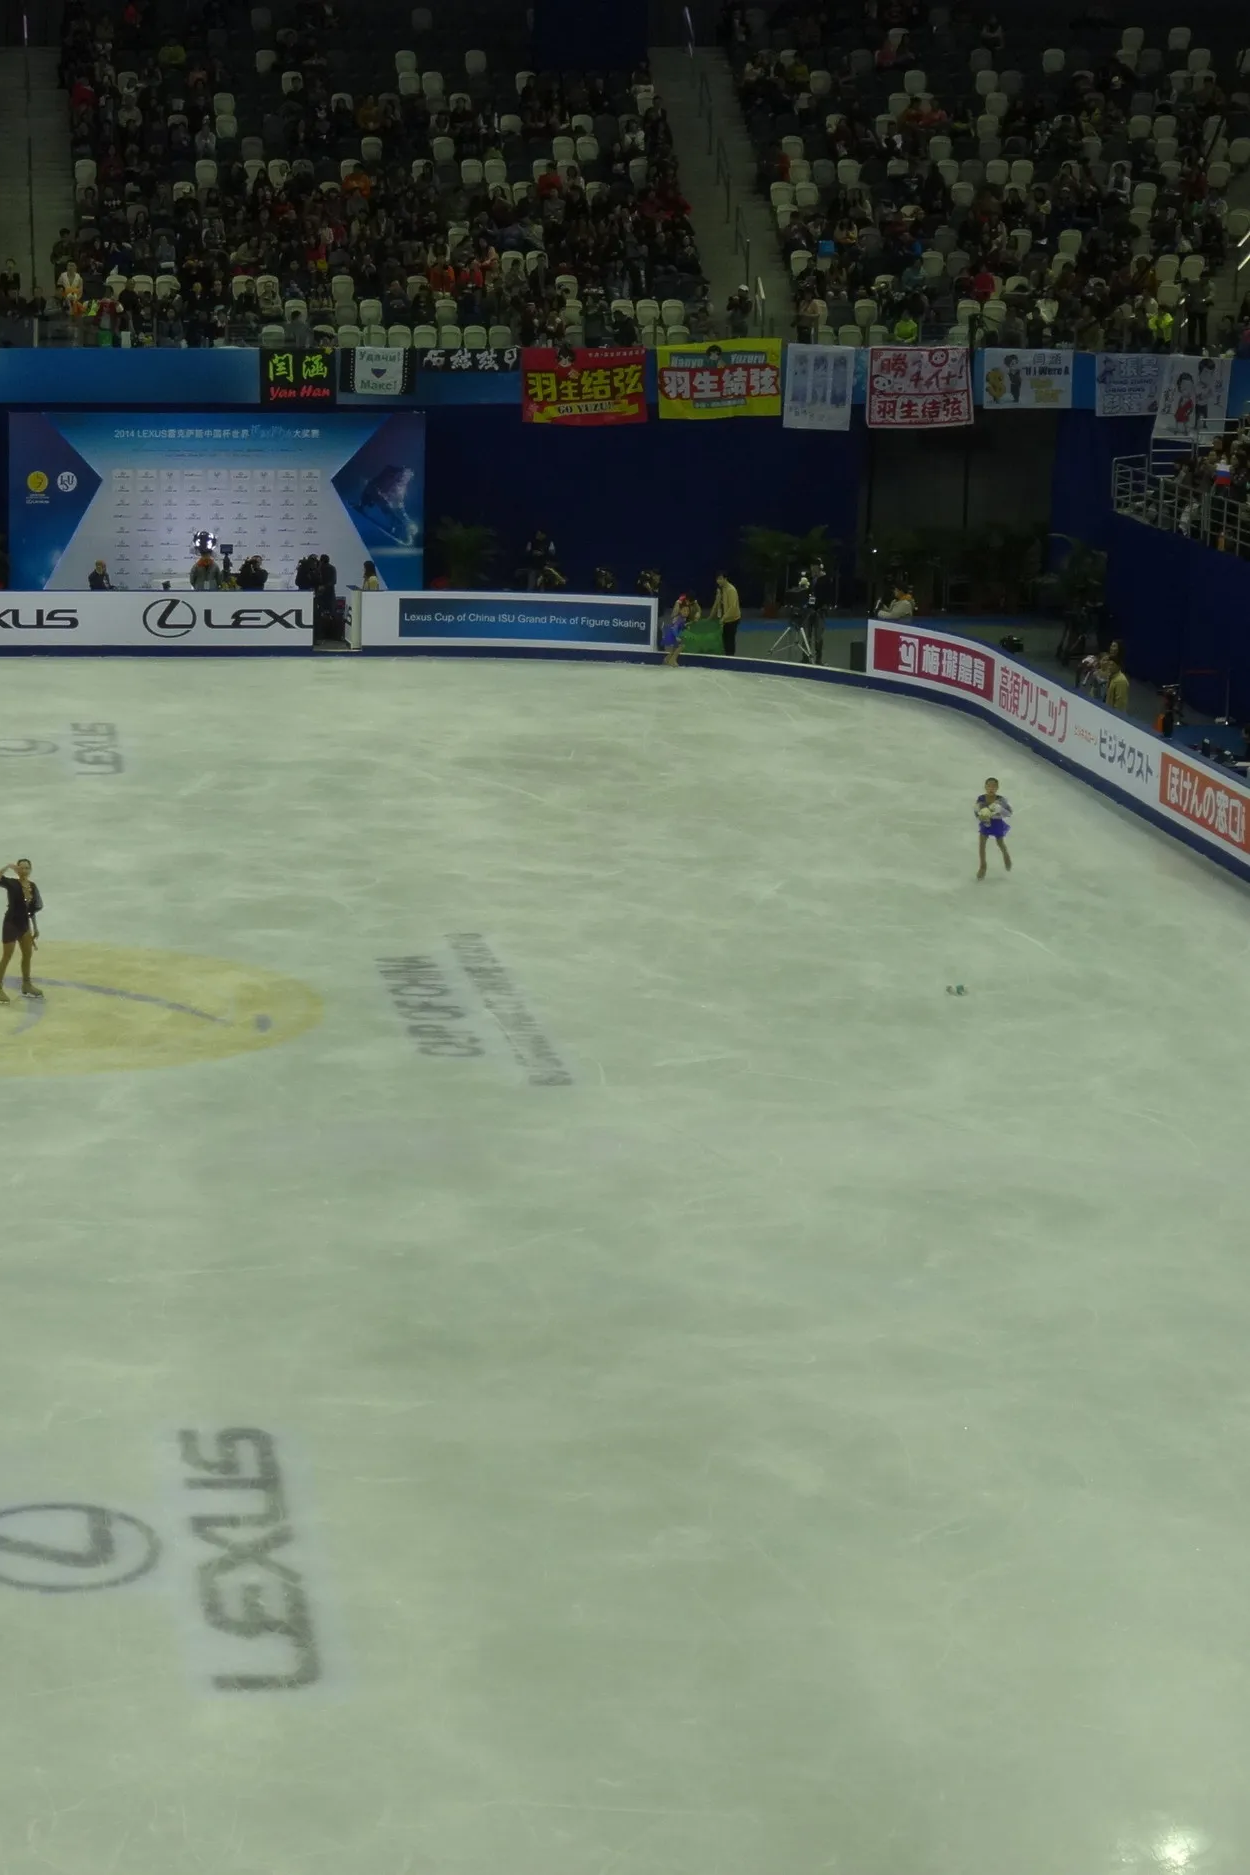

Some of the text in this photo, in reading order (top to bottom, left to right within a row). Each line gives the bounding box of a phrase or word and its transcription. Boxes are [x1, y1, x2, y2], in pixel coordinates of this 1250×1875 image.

[269, 384, 331, 401] Yan Han
[113, 429, 135, 438] 2014
[404, 612, 646, 630] Lexus Cup of China ISU Grand Prix of Figure Skating
[998, 665, 1069, 744] 高須クリニック
[1098, 728, 1154, 785] ビジネクスト
[1167, 763, 1244, 844] ほけんの窓口
[177, 1426, 323, 1692] LEXUS
